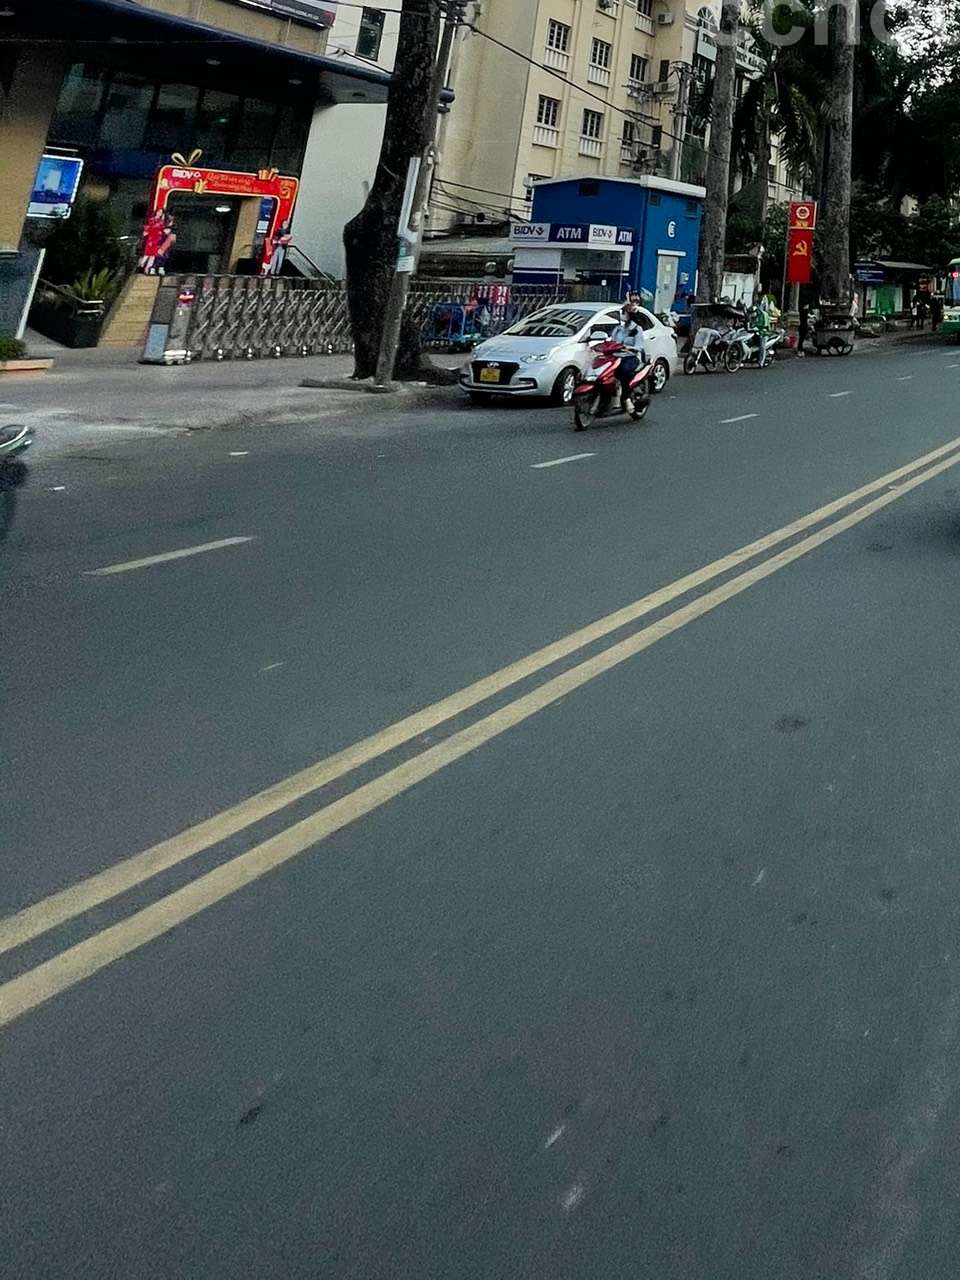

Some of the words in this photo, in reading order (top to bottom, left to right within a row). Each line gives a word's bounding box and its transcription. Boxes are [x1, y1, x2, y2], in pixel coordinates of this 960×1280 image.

[513, 225, 536, 235] BIDV
[557, 227, 582, 239] ATM
[592, 227, 607, 238] BIDV
[618, 231, 633, 243] ATM
